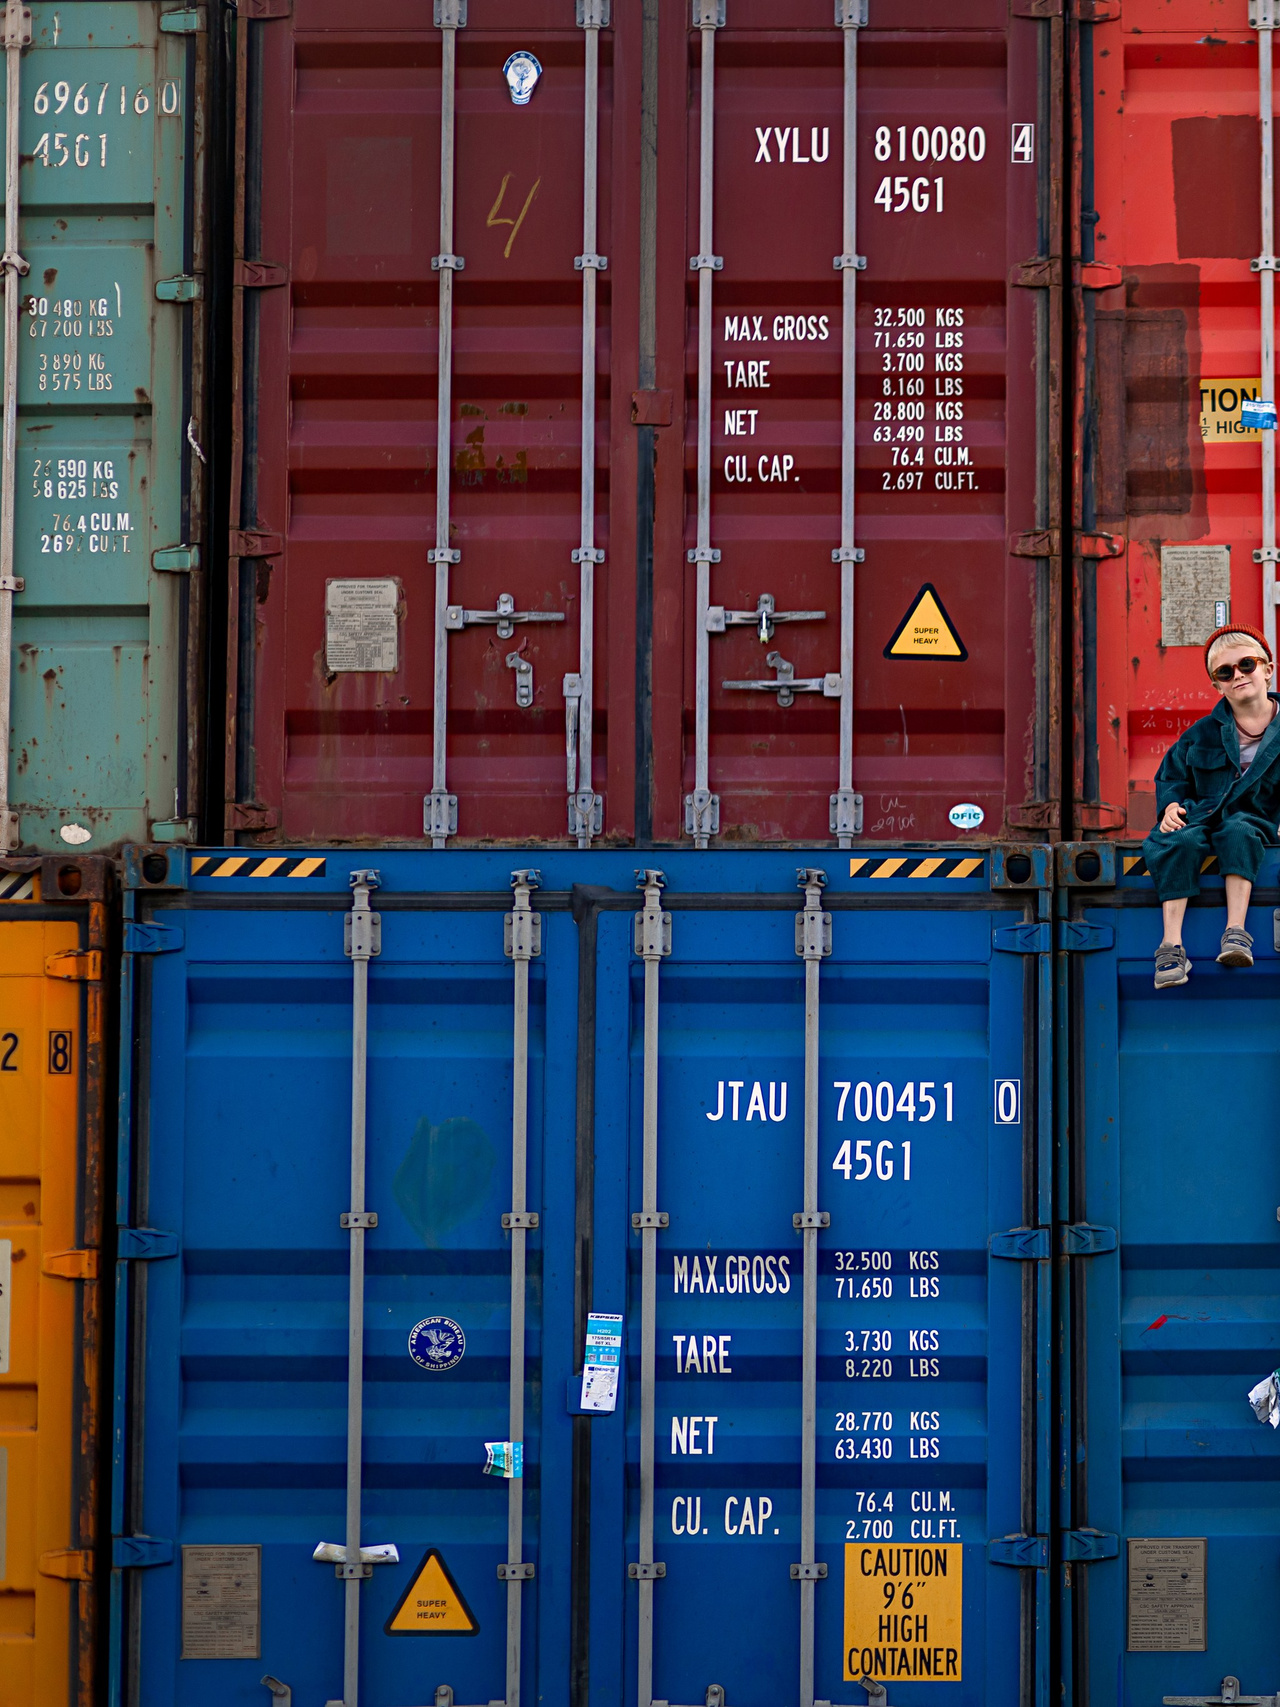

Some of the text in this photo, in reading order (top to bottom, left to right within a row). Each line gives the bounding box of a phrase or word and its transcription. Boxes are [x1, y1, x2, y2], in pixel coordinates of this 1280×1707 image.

[35, 82, 177, 114] 696716 0
[755, 126, 1032, 162] XYLU 810080 4
[875, 177, 943, 212] 45G1
[486, 172, 541, 258] 4
[725, 316, 828, 340] MAX. GROSS
[875, 308, 963, 326] 32,500 KGS
[874, 332, 963, 347] 71,650 LBS
[724, 361, 770, 387] TARE
[883, 353, 963, 371] 3,700 KGS
[883, 378, 962, 395] 8,160 LBS
[725, 410, 758, 435] NET
[874, 402, 963, 420] 28,800 KGS
[874, 426, 962, 441] 63,490 LBS
[892, 447, 973, 465] 76.4 CU.M.
[725, 455, 799, 482] CU. CAP.
[883, 472, 978, 489] 2,697 CU.FT.
[51, 1033, 70, 1072] 8
[706, 1081, 1016, 1122] JTAU 700451 0
[833, 1140, 910, 1180] 45G1
[835, 1251, 938, 1270] 32,500 KGS
[674, 1256, 790, 1293] MAX.GROSS
[836, 1277, 939, 1298] 71,650 LBS
[411, 1319, 463, 1344] AMERICAN BUREAU
[846, 1330, 938, 1351] 3,730 KGS
[426, 1355, 459, 1368] SHIPPING
[673, 1336, 731, 1373] TARE
[846, 1358, 939, 1377] 8,220 LBS
[836, 1412, 939, 1431] 28,770 KGS
[672, 1417, 717, 1454] NET
[835, 1438, 939, 1459] 63,430 LBS
[856, 1491, 955, 1512] 76.4 CU.M.
[672, 1497, 779, 1535] CU. CAP.
[846, 1520, 960, 1538] 2,700 CU.FT.
[861, 1549, 946, 1576] CAUTION
[879, 1615, 927, 1642] HIGH
[849, 1648, 957, 1676] CONTAINER
